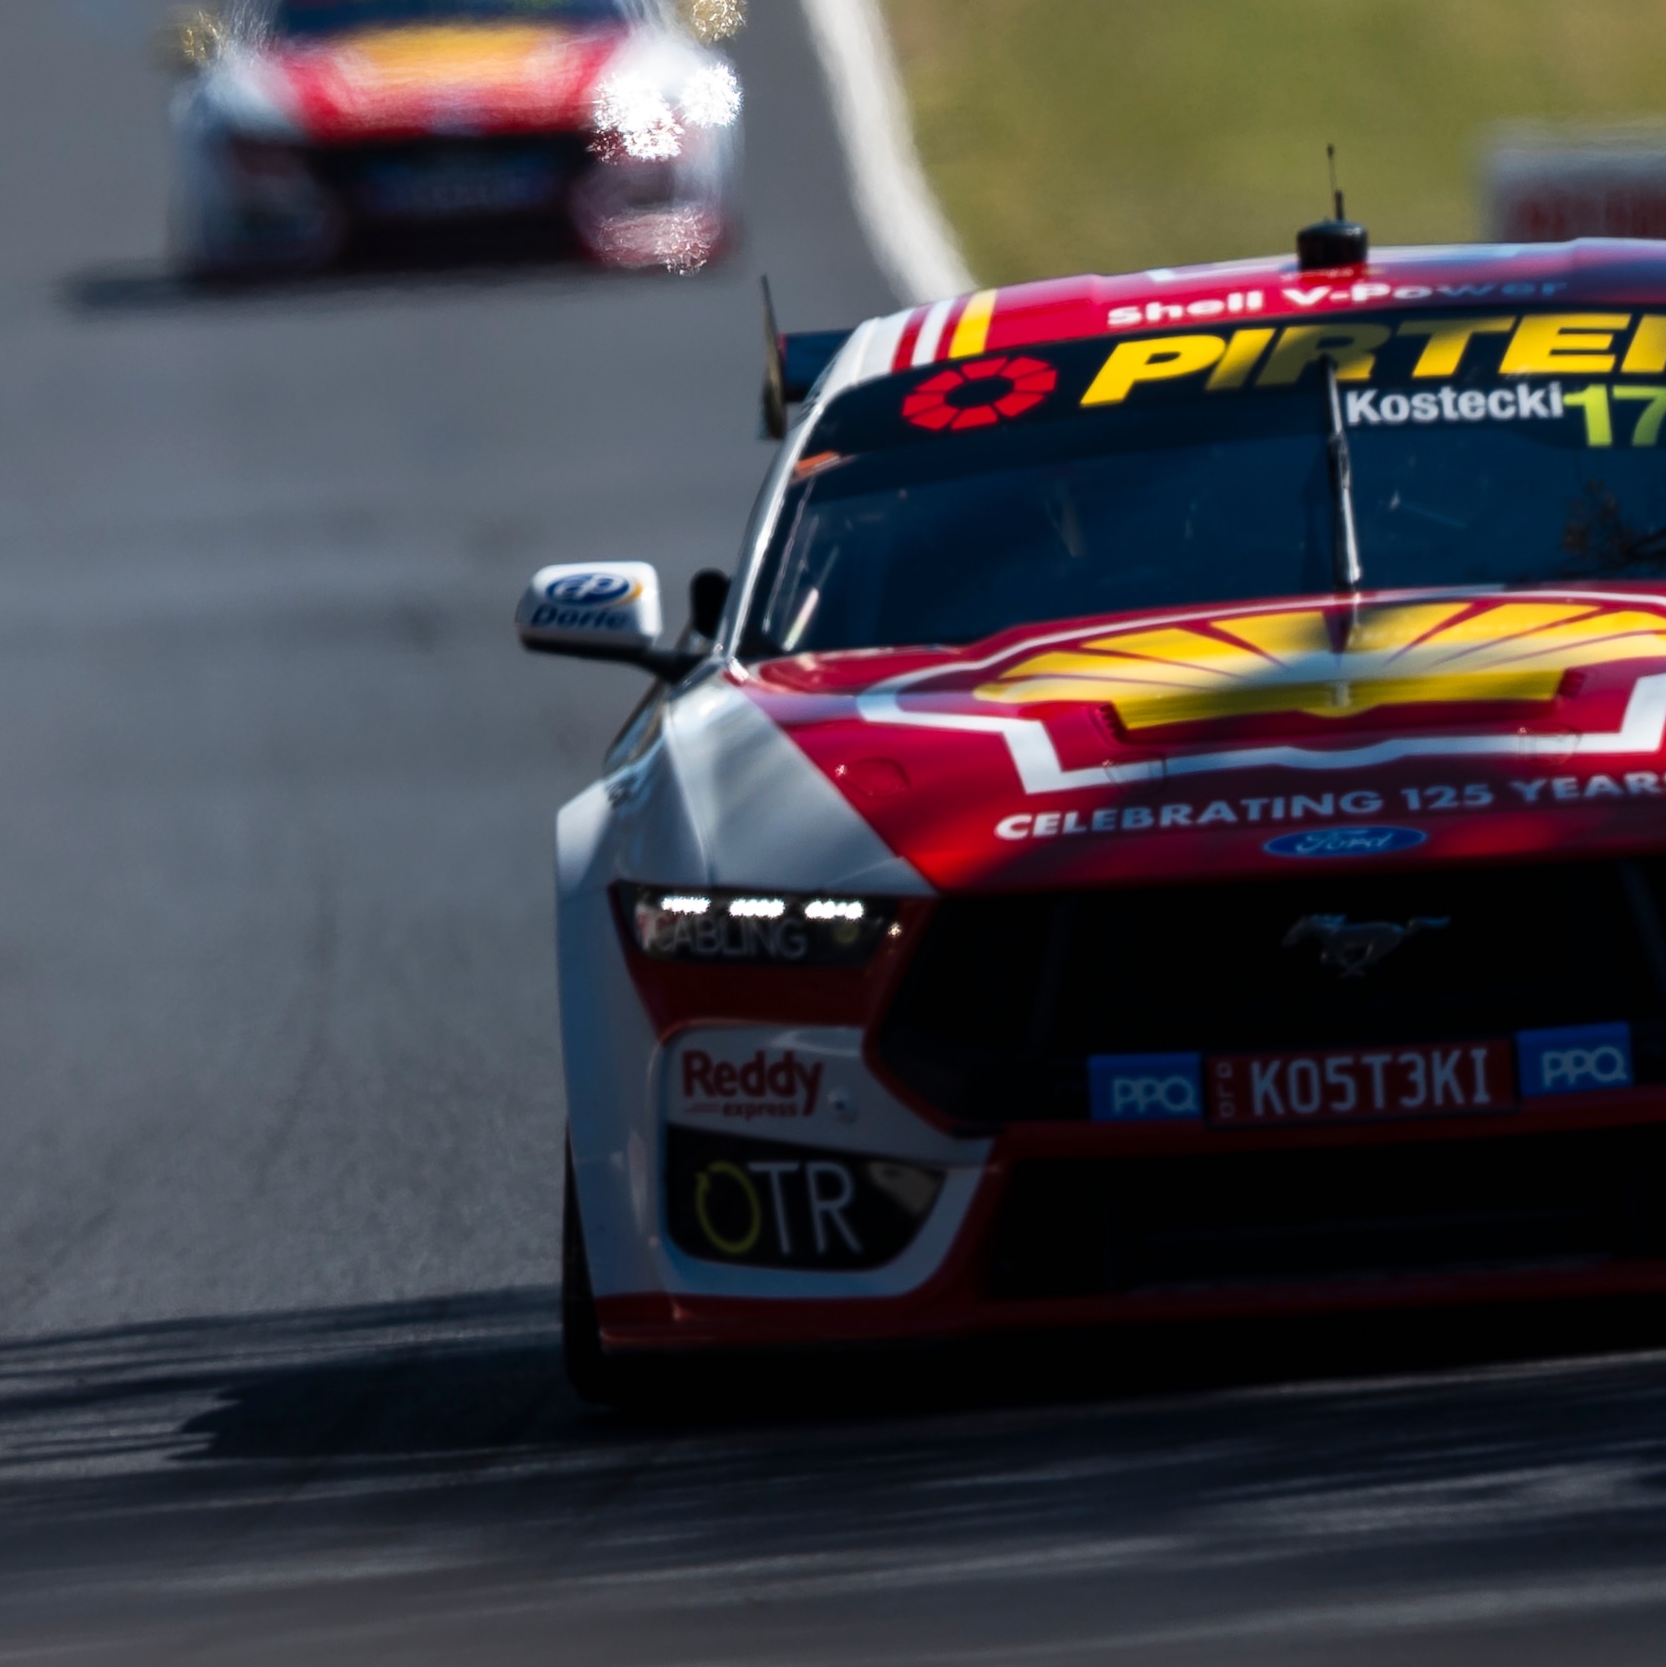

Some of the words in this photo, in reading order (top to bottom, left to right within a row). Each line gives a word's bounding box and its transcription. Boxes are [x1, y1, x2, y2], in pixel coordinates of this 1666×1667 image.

[1107, 290, 1264, 326] Shell
[1282, 280, 1568, 307] V-Power
[1345, 381, 1564, 425] Kostecki
[530, 602, 628, 630] Doric
[993, 789, 1384, 841] CELEBRATING
[1400, 782, 1494, 812] 125
[1294, 828, 1395, 855] Ford
[682, 1049, 824, 1118] Reddy
[1542, 1045, 1628, 1088] PPQ
[722, 1101, 798, 1121] express
[1112, 1075, 1198, 1114] PPQ
[692, 1158, 867, 1258] OTR
